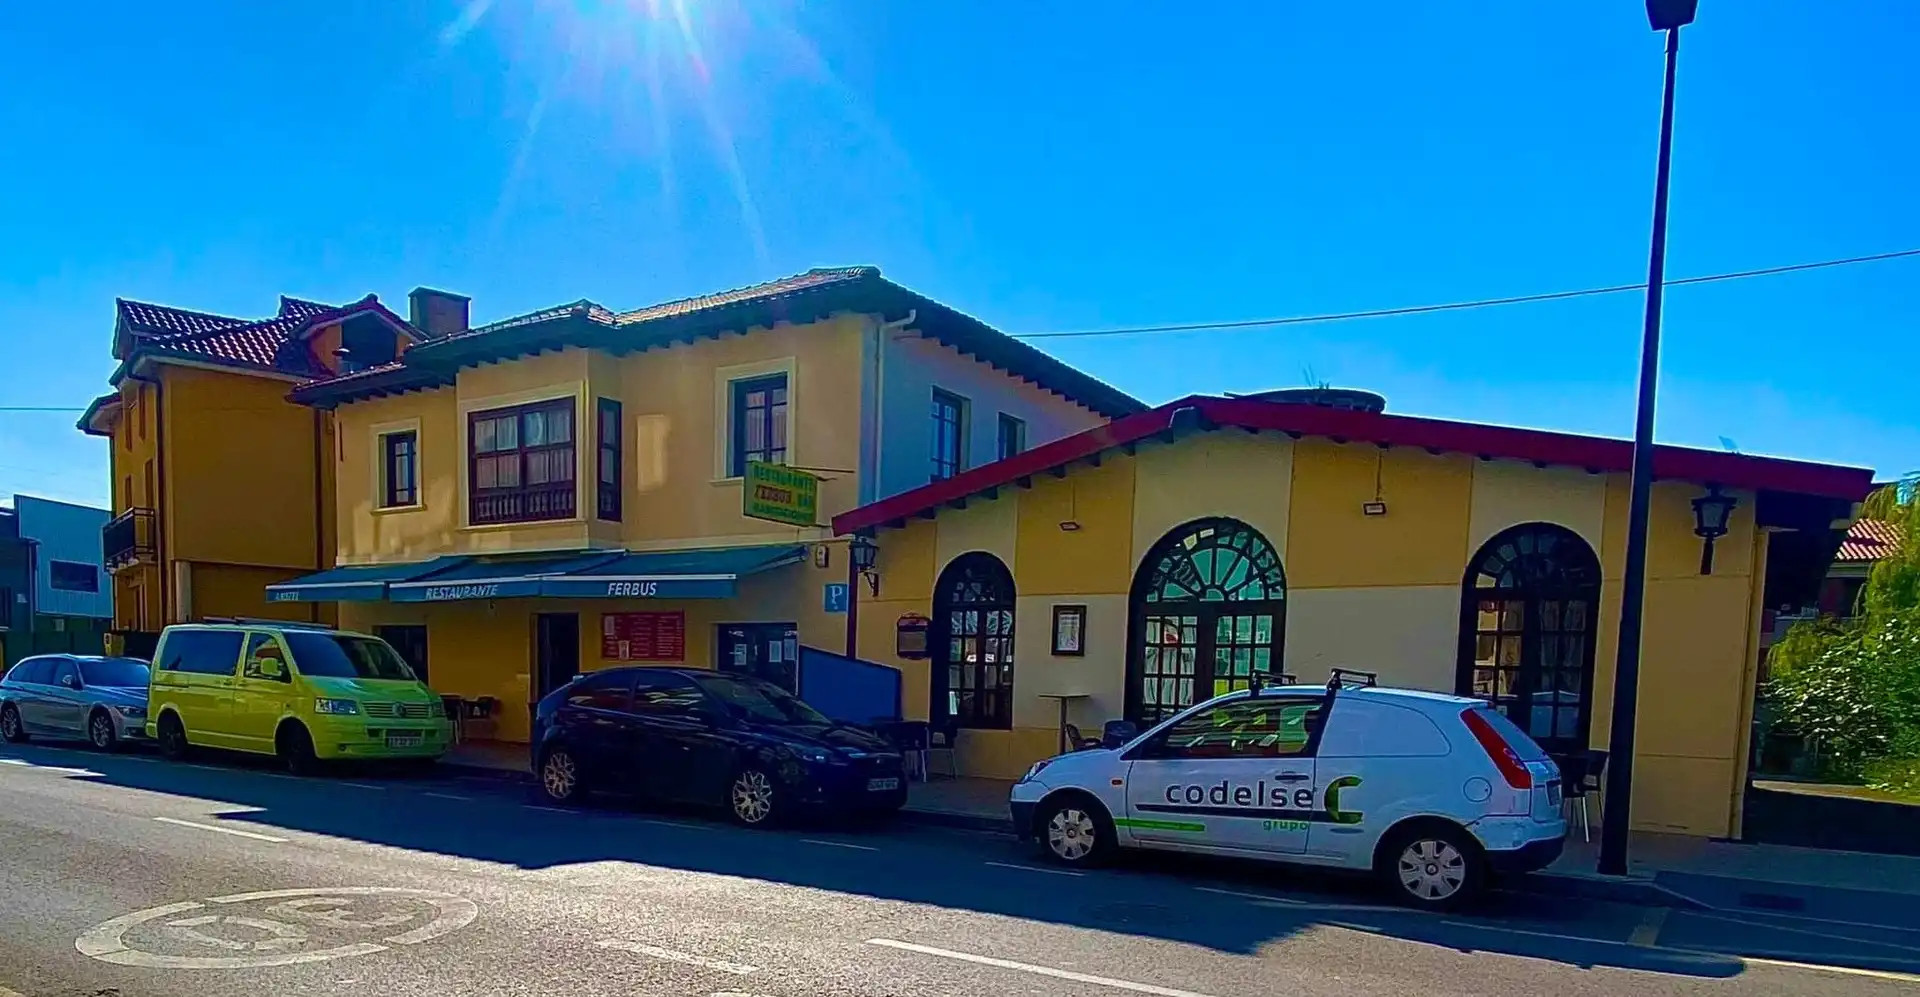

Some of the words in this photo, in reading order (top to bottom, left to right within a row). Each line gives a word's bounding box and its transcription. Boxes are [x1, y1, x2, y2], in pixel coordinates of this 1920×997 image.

[753, 464, 813, 490] RESTAURANTE
[425, 584, 499, 600] RESTAURANTE
[607, 582, 658, 597] FERBUS
[1262, 819, 1309, 832] grupo
